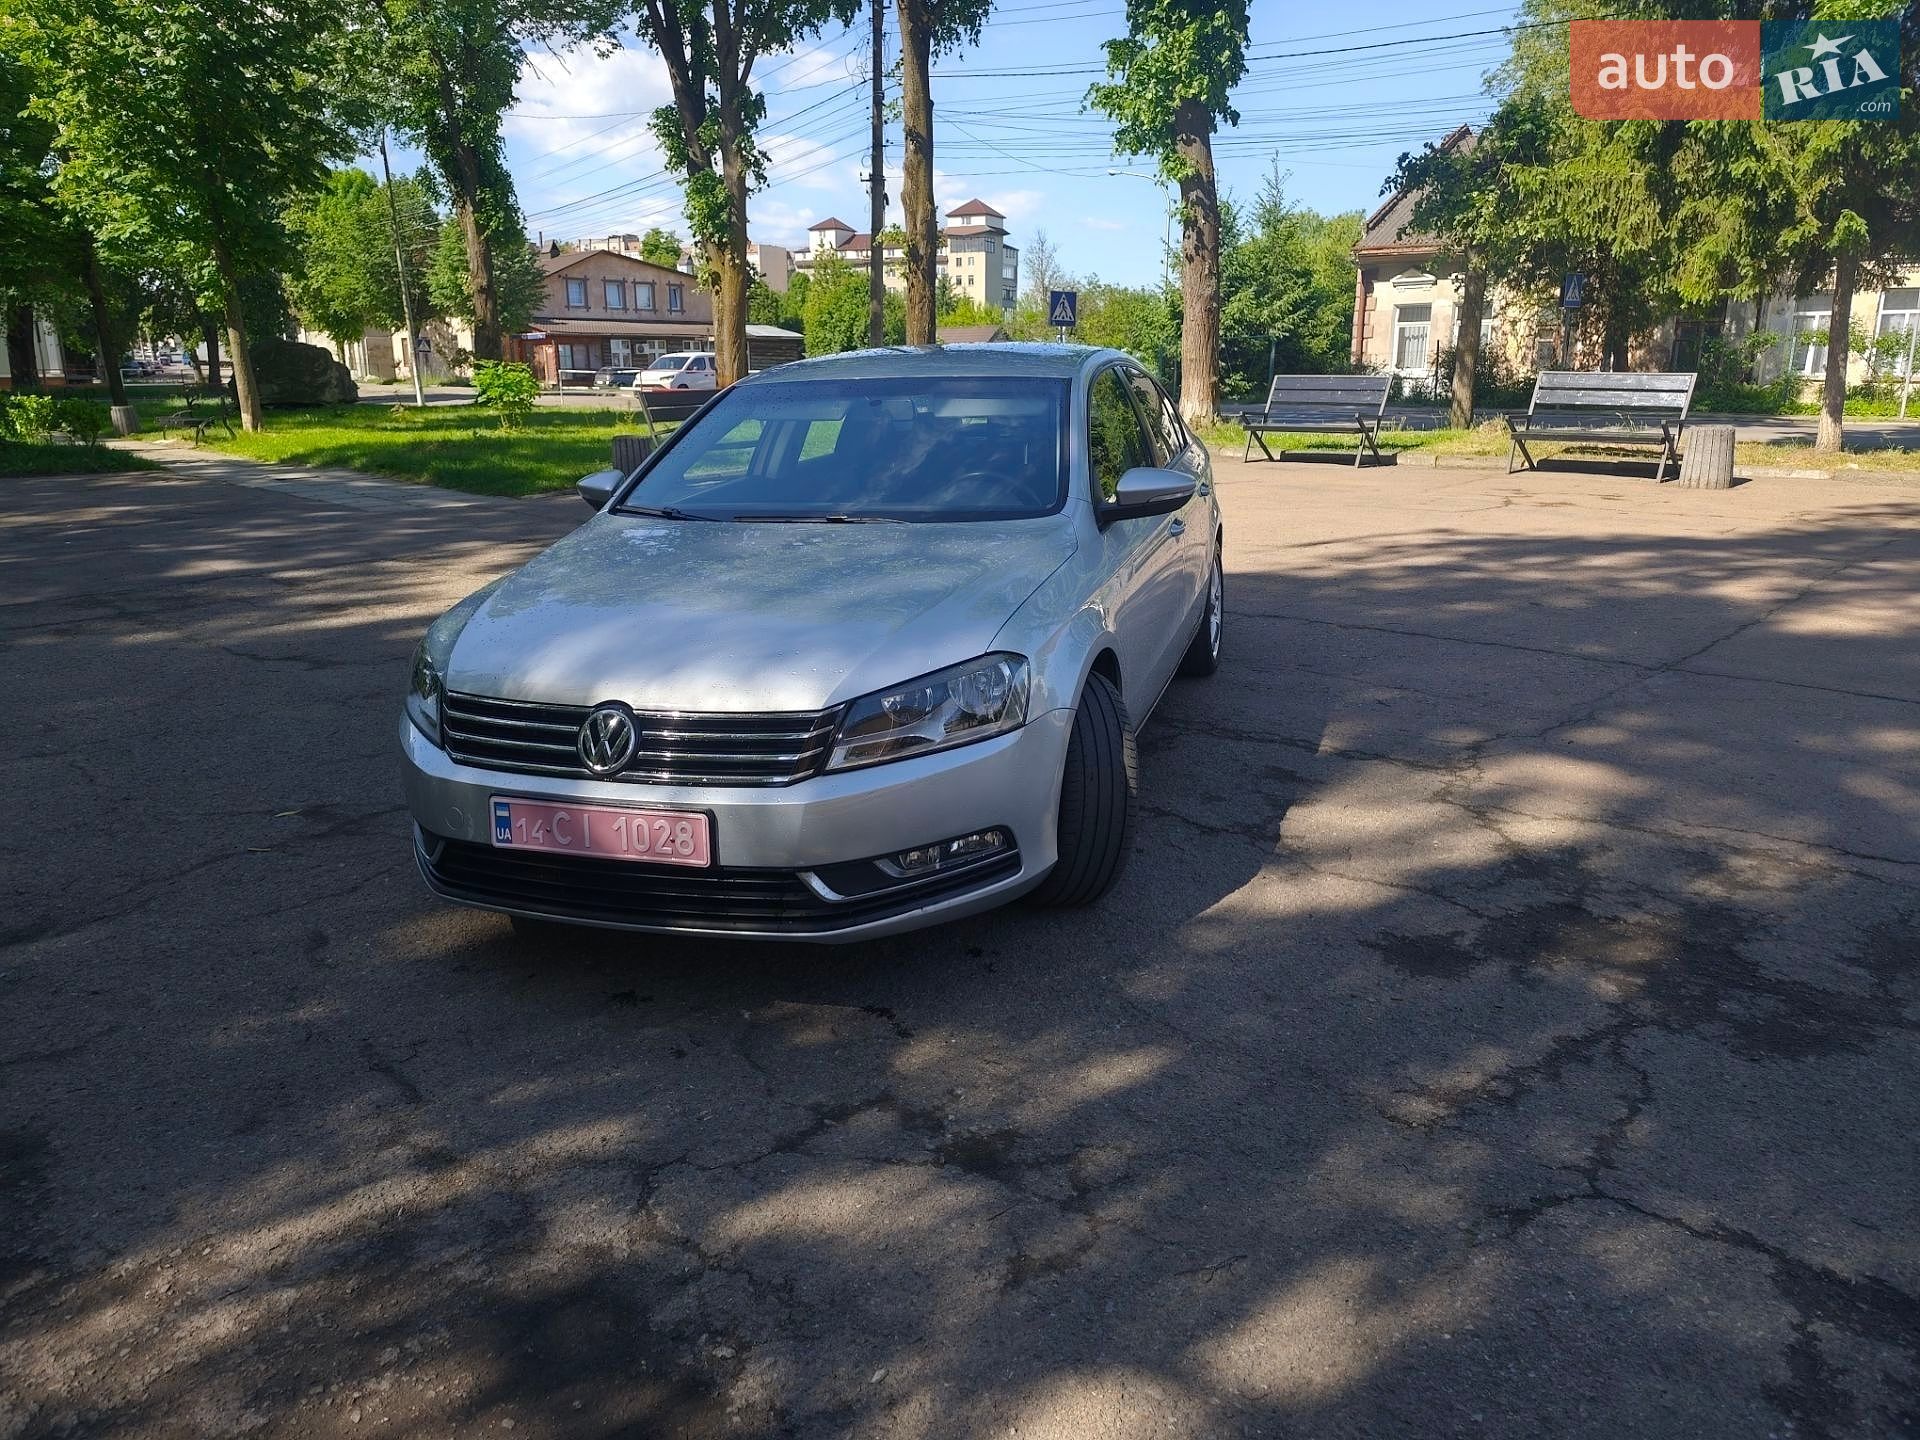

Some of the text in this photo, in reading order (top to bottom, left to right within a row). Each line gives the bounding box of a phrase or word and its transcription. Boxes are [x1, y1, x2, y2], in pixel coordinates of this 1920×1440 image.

[580, 711, 633, 770] VW
[496, 826, 512, 841] UA
[611, 816, 696, 856] 1028
